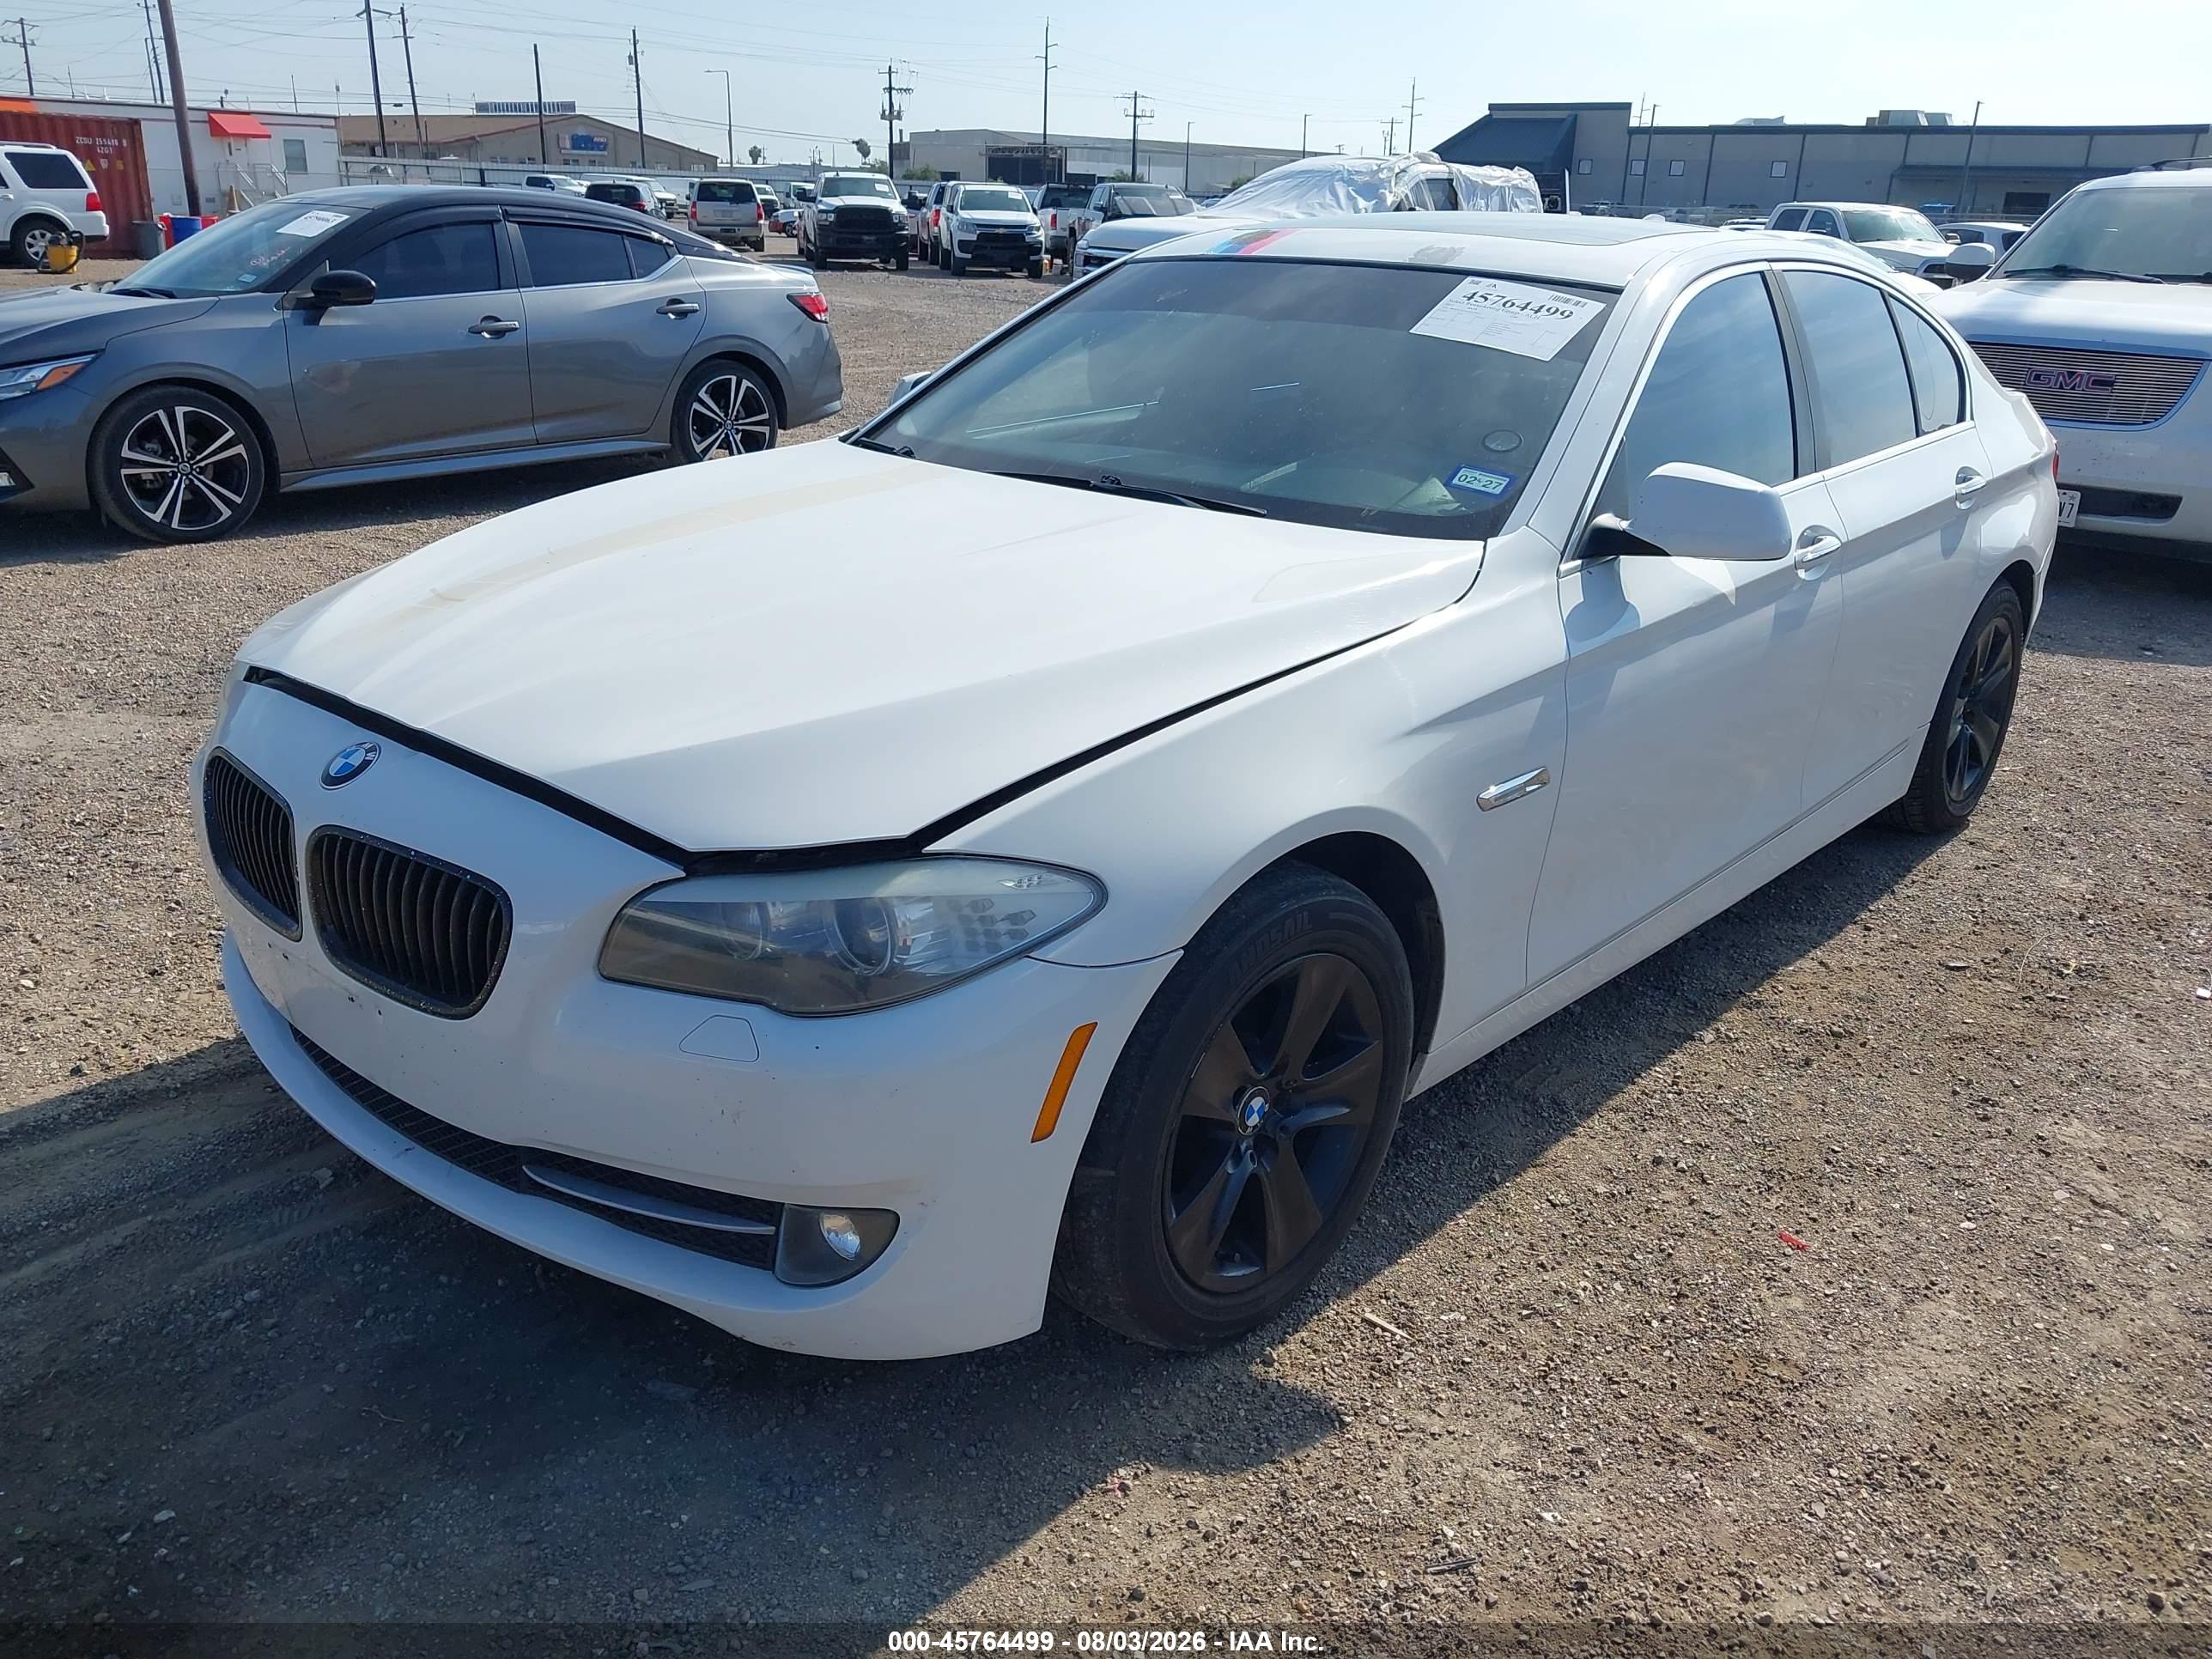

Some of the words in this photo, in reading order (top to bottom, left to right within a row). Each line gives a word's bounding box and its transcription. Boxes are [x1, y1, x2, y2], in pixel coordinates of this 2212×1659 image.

[1462, 290, 1575, 320] 45764499
[2025, 368, 2117, 393] GMC
[1457, 473, 1478, 485] 02
[1481, 479, 1504, 490] 27
